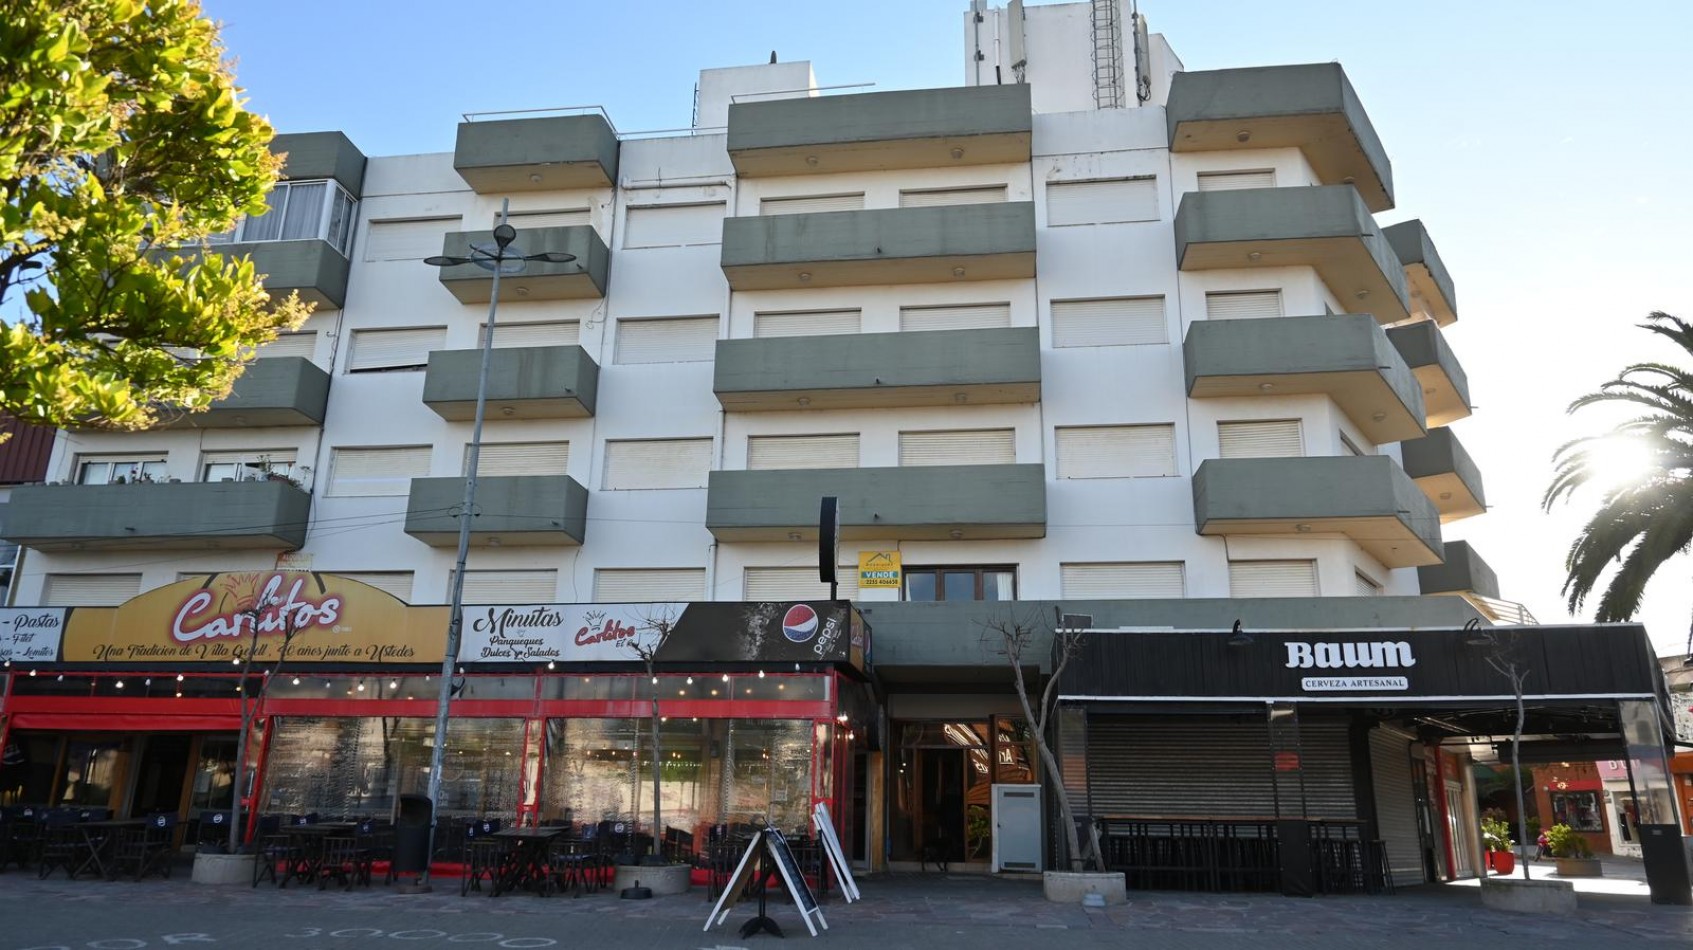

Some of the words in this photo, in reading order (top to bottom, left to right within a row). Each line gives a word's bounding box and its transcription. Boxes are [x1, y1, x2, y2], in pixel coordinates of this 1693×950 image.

[172, 574, 341, 642] Carlitos
[14, 613, 60, 632] Pastas
[473, 606, 564, 638] Minutas
[574, 619, 636, 646] Carlitos
[489, 637, 545, 649] Panqueques
[813, 617, 837, 655] pepsi
[92, 644, 124, 661] Una
[128, 644, 177, 658] Tradicion
[179, 644, 190, 656] de
[196, 643, 228, 659] Villa
[297, 645, 322, 657] años
[320, 645, 351, 660] junto
[353, 646, 362, 656] a
[365, 644, 416, 661] Ustedes
[481, 646, 511, 658] Dulces
[523, 645, 561, 658] Salados
[1284, 641, 1416, 668] Baum
[1305, 680, 1347, 688] CERVEZA
[1350, 679, 1405, 687] ARTESANAL
